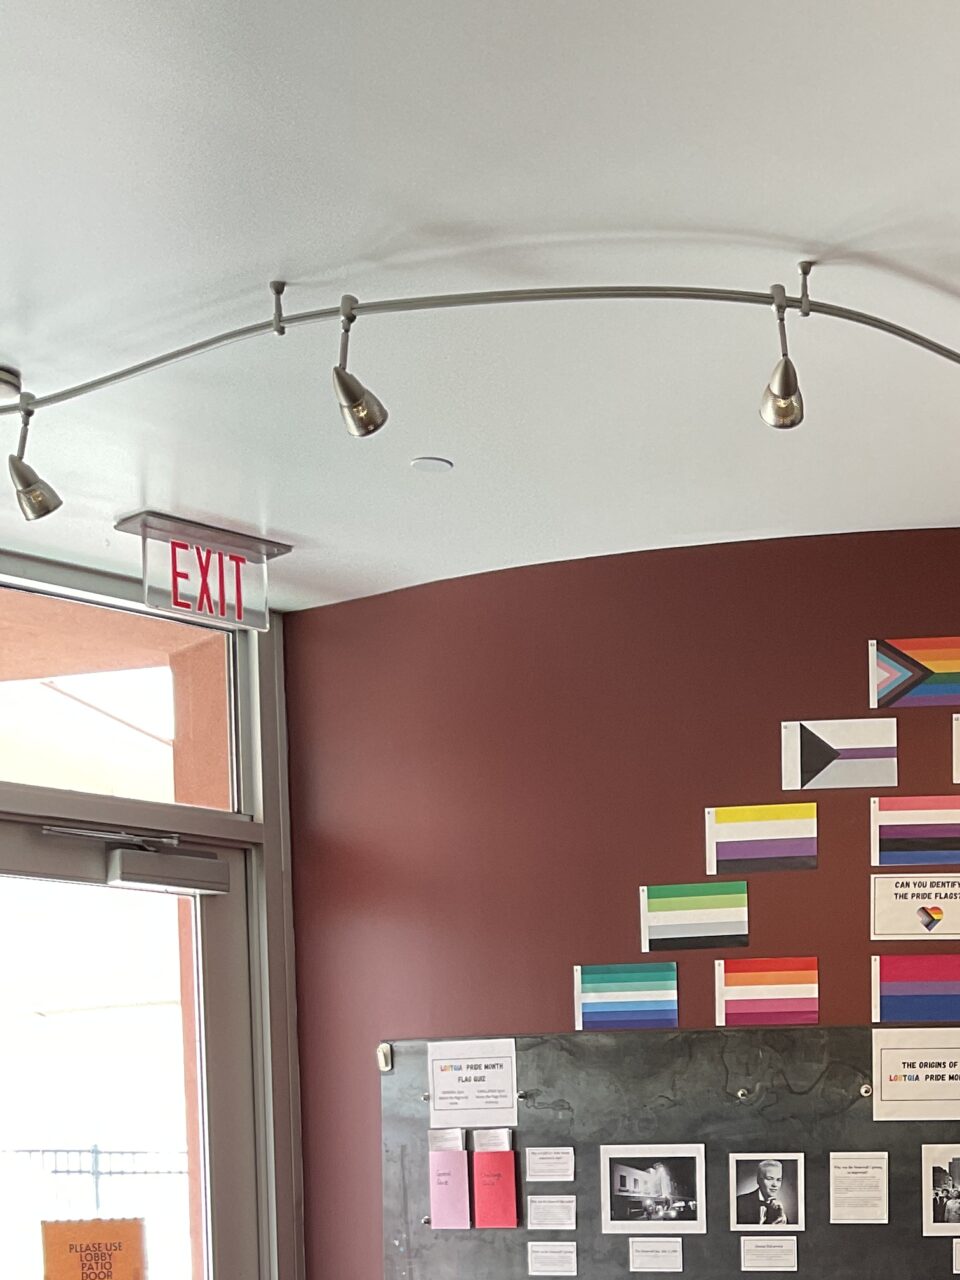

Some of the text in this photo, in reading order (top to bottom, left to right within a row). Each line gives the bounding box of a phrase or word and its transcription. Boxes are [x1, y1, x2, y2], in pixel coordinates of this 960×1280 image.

[170, 539, 248, 621] EXIT
[889, 1074, 920, 1082] LGBTQIA
[69, 1242, 123, 1253] PLEASE USE
[80, 1252, 113, 1262] LOBBY
[81, 1261, 112, 1271] PATIO
[81, 1271, 113, 1280] DOOR
